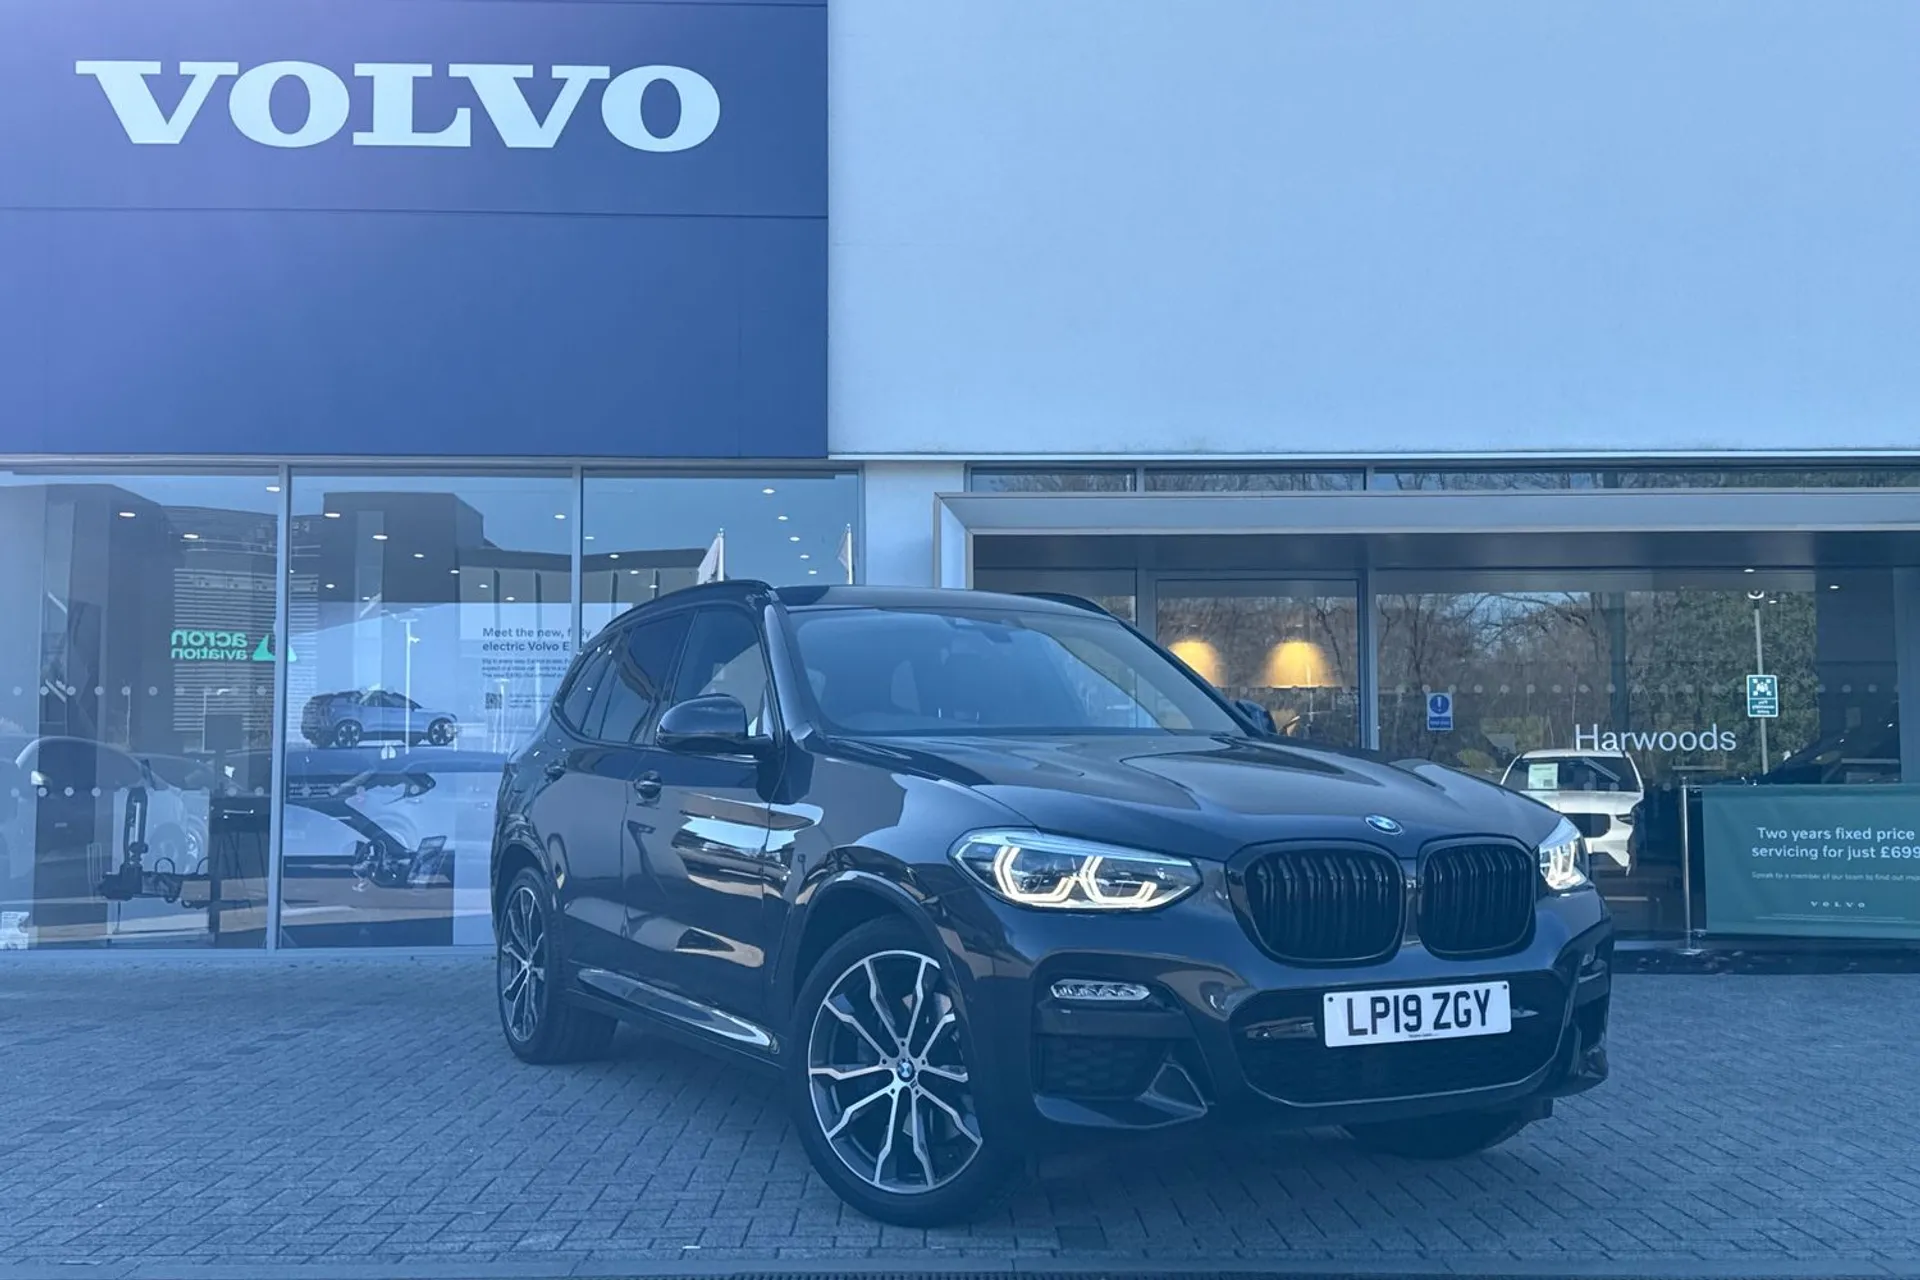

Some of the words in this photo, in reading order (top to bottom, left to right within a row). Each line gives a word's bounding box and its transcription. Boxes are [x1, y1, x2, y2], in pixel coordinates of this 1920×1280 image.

[75, 60, 721, 153] VOLVO
[482, 627, 513, 638] Meet
[516, 627, 534, 638] the
[537, 629, 565, 639] new,
[482, 641, 525, 652] electric
[527, 641, 560, 652] Volvo
[1575, 723, 1737, 751] Harwoods
[1757, 827, 1787, 840] Two
[1791, 829, 1831, 842] years
[1835, 827, 1872, 840] fixed
[1876, 828, 1915, 843] price
[1751, 845, 1818, 860] servicing
[1822, 845, 1844, 858] for
[1847, 845, 1876, 861] just
[1880, 846, 1920, 859] £699
[1346, 994, 1423, 1036] LP19
[1432, 989, 1490, 1031] ZGY
